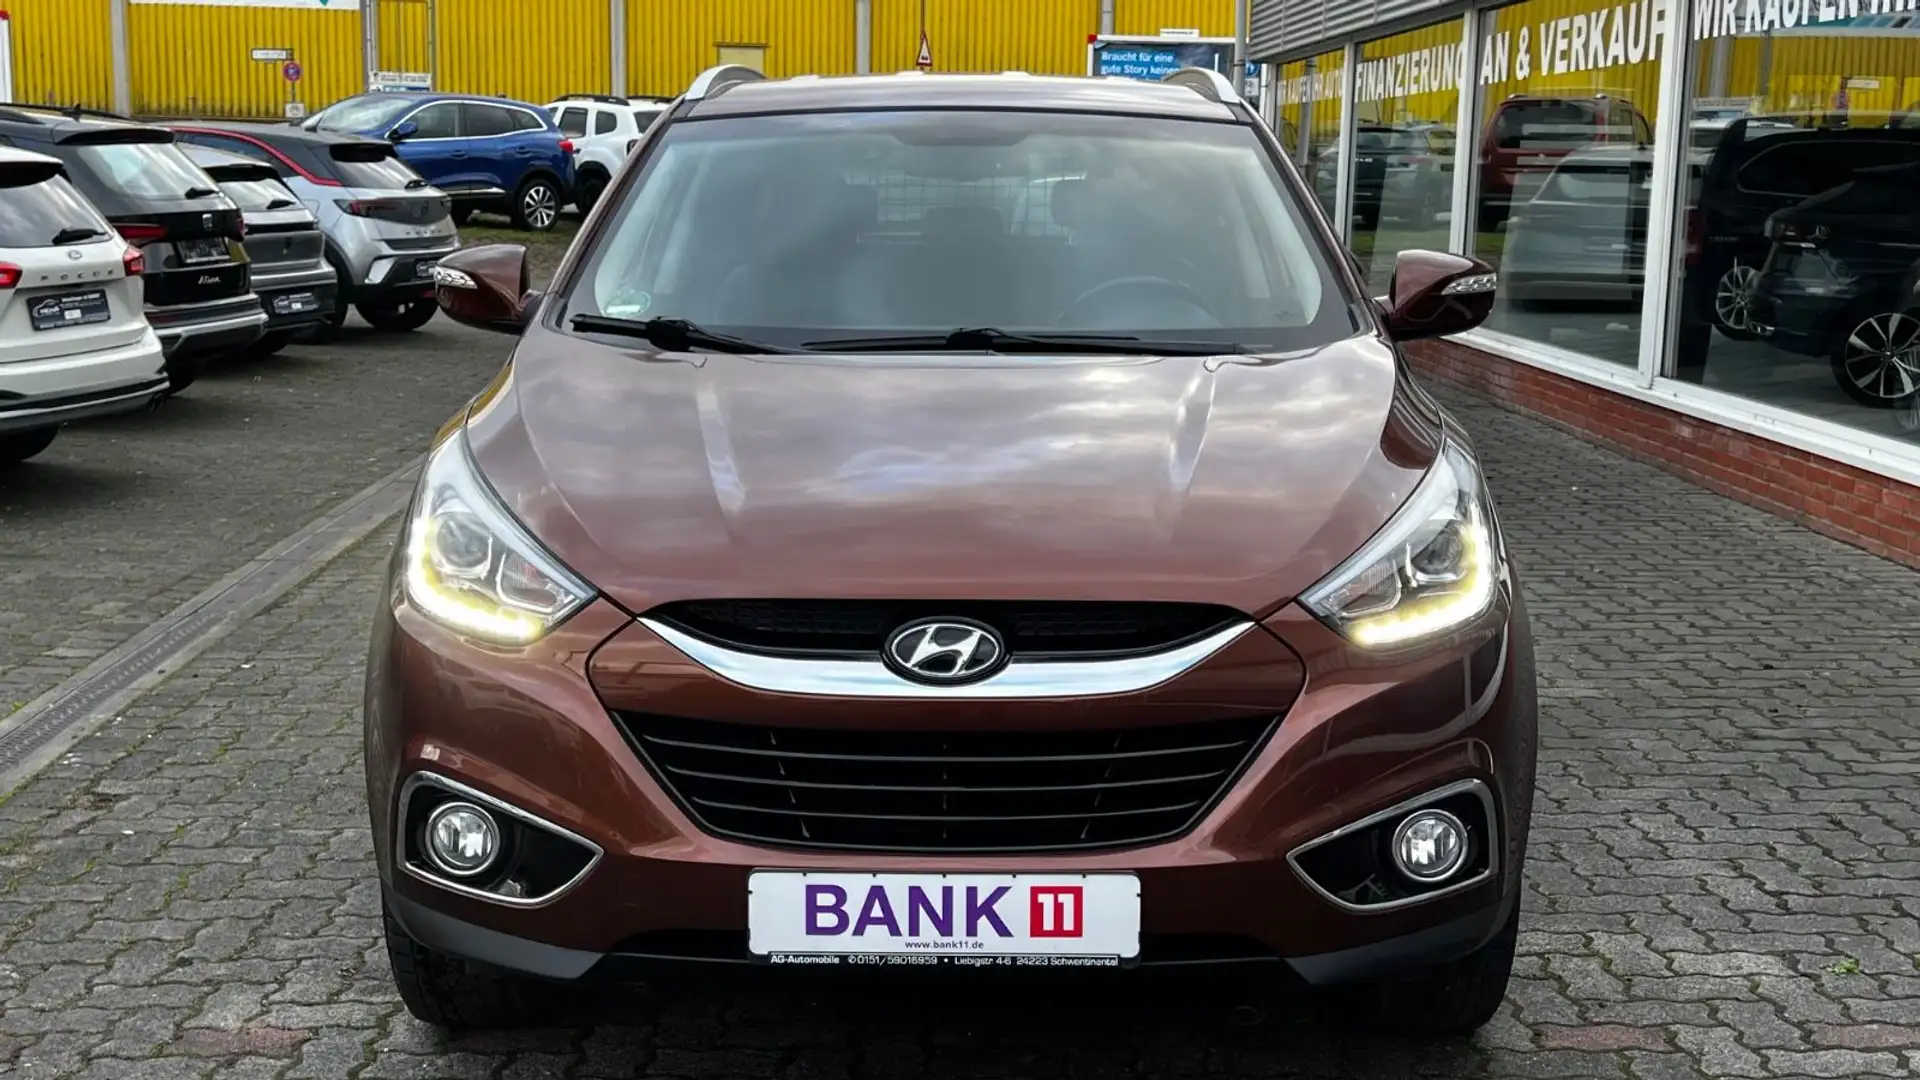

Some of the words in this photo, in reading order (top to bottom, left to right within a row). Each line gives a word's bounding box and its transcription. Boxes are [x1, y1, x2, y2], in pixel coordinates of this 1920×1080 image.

[1480, 31, 1510, 86] AN
[1515, 26, 1530, 81] &
[1539, 0, 1667, 77] VERKAUF
[1101, 51, 1137, 62] Braucht
[1139, 51, 1152, 62] für
[1154, 53, 1173, 62] eine
[1101, 65, 1121, 76] gute
[1123, 64, 1149, 76] Story
[805, 884, 1014, 938] BANK
[1036, 892, 1076, 932] 11
[905, 939, 985, 950] www.bank11.de
[770, 955, 840, 965] AG-Automobile
[1016, 956, 1049, 967] 24223
[1050, 956, 1119, 967] Schwentinental
